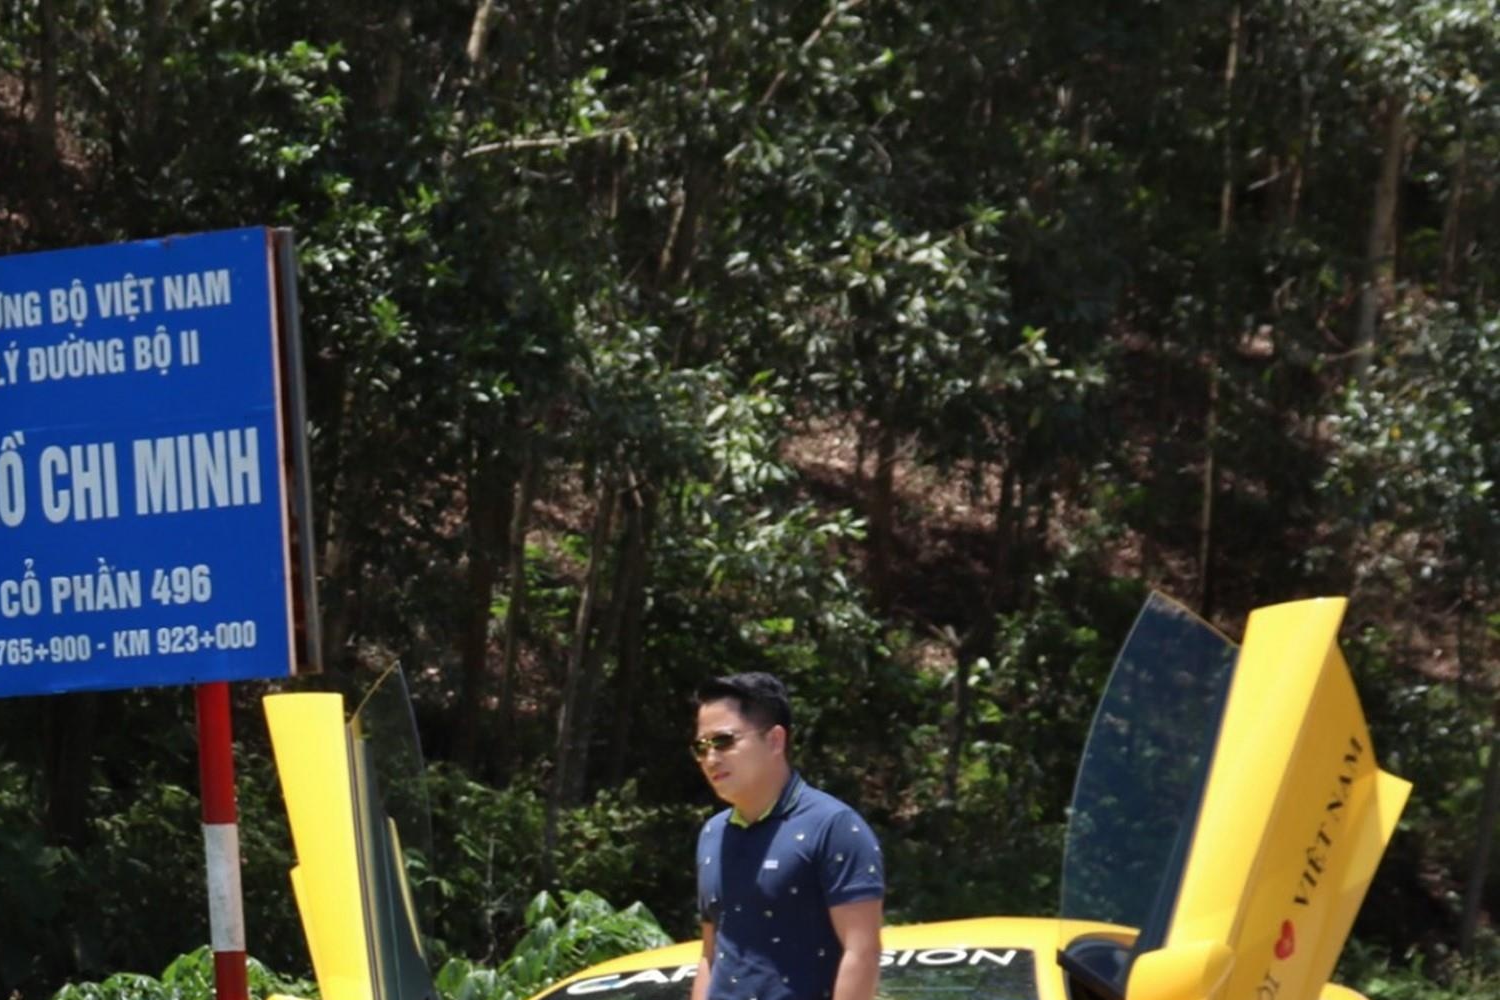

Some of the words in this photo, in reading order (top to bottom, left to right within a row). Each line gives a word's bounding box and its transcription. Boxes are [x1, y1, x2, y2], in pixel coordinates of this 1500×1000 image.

[50, 279, 88, 327] BỘ
[95, 273, 154, 322] VIỆT
[163, 269, 231, 311] NAM
[28, 333, 125, 382] ĐƯỜNG
[133, 325, 171, 375] BỘ
[180, 330, 199, 366] II
[39, 442, 119, 524] CHI
[133, 427, 262, 515] MINH
[0, 559, 41, 617] CỔ
[51, 557, 142, 614] PHẦN
[151, 564, 212, 606] 496
[113, 628, 150, 658] KM
[157, 620, 256, 654] 923+000
